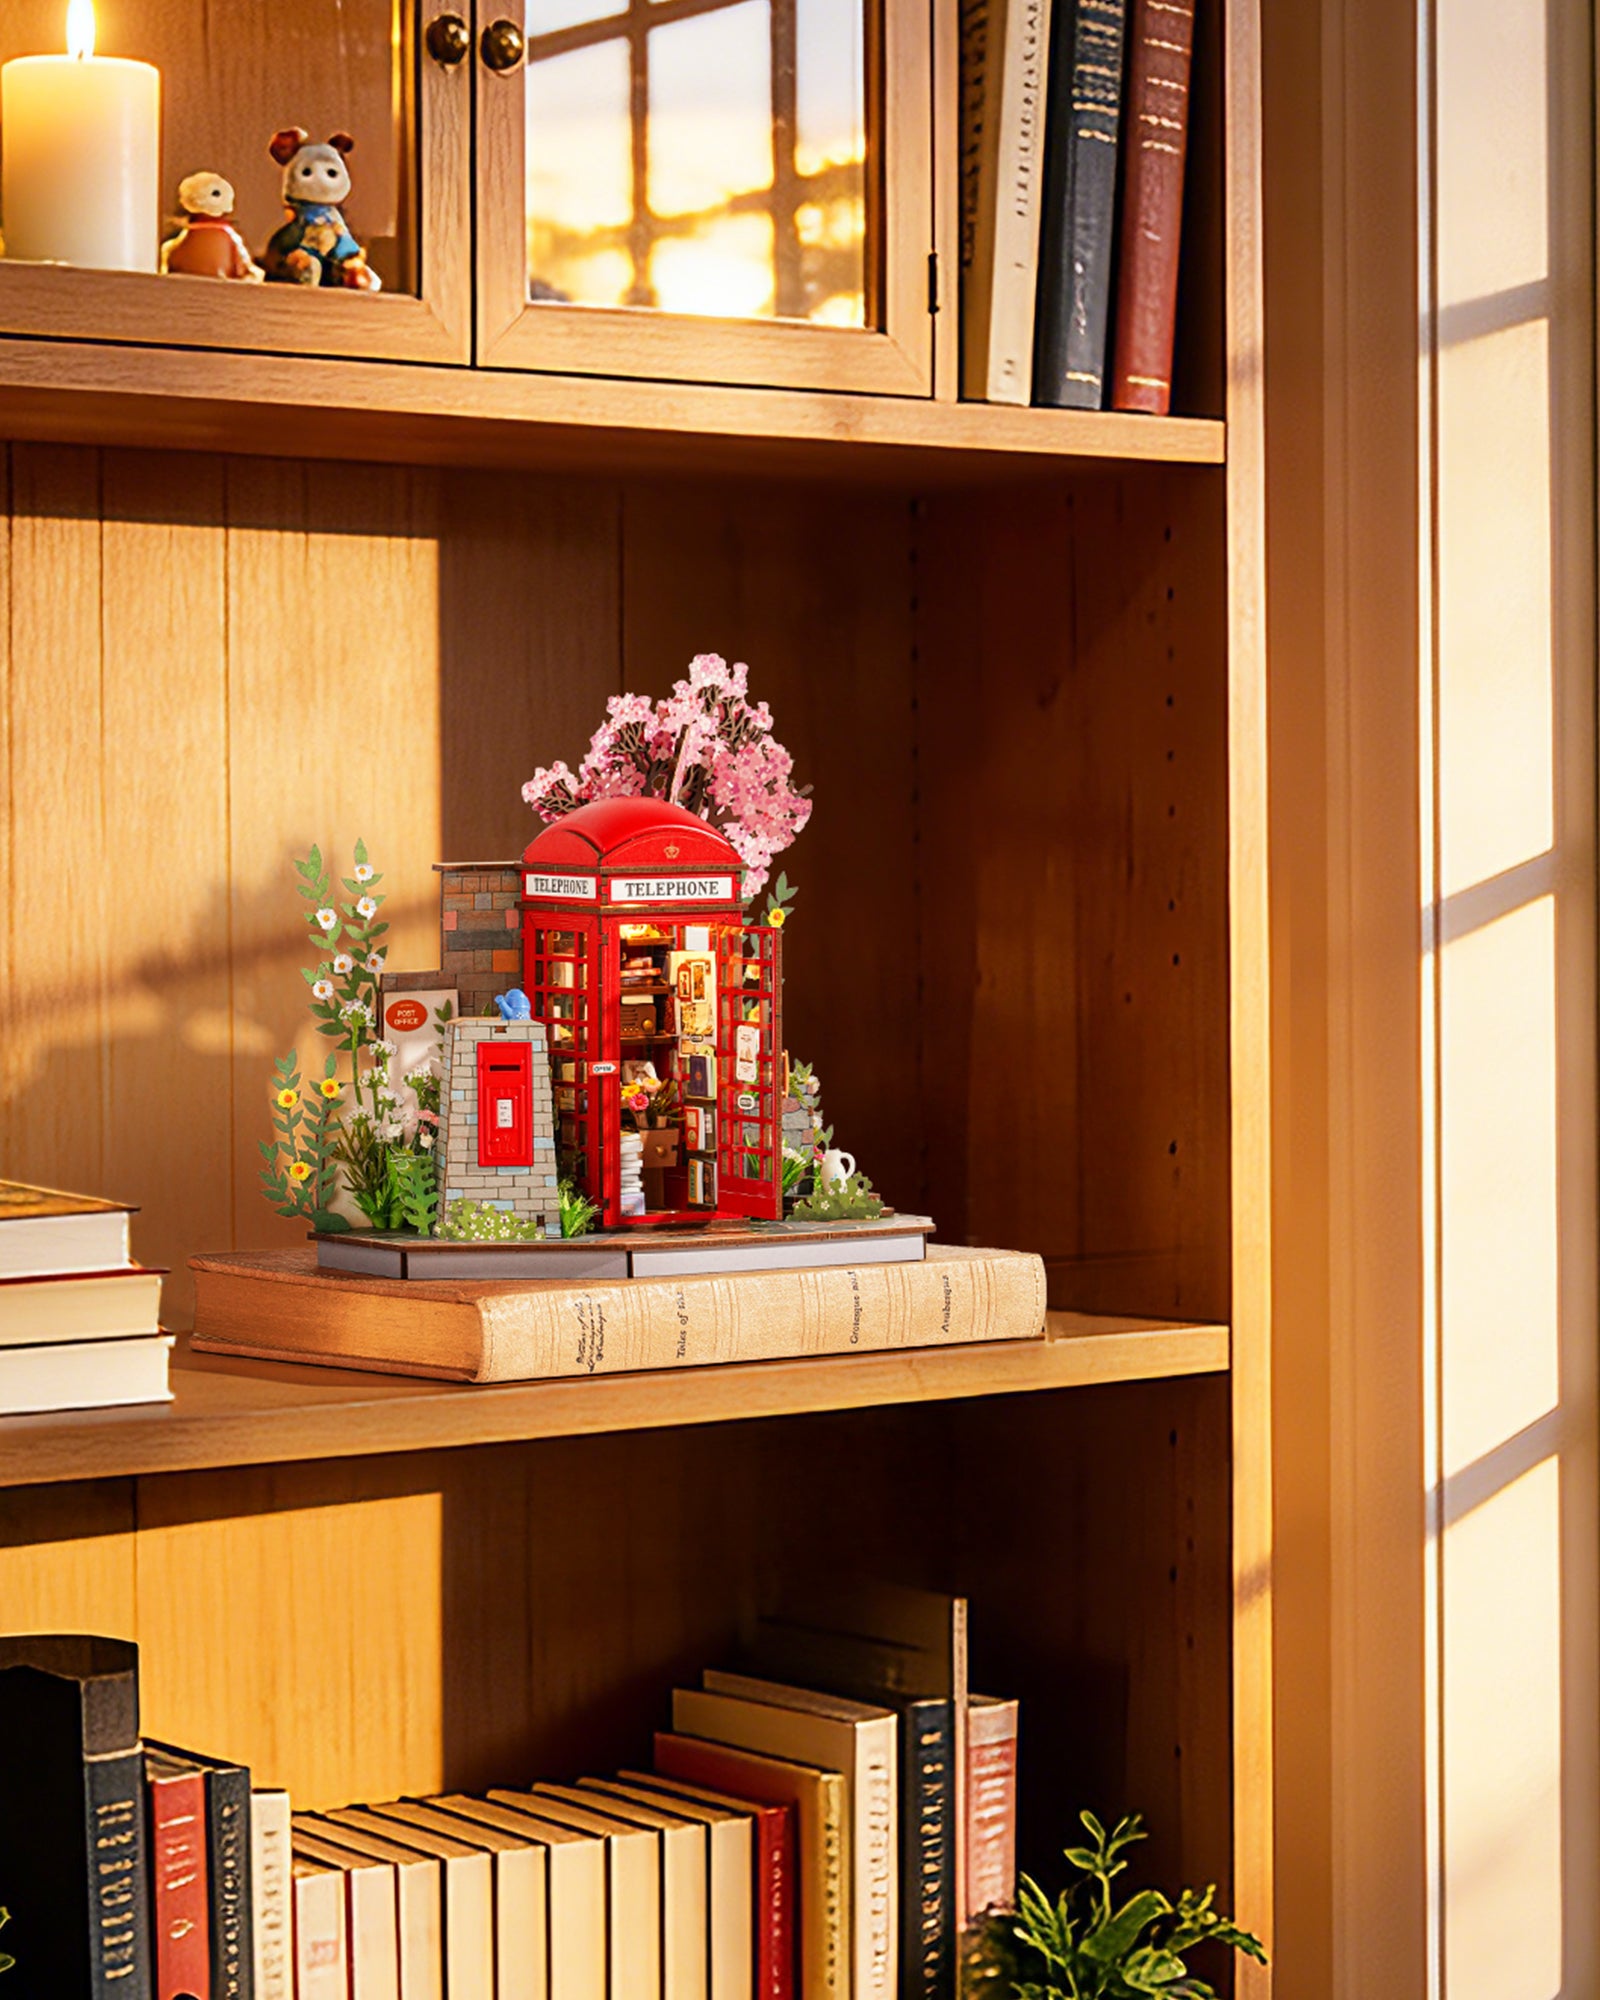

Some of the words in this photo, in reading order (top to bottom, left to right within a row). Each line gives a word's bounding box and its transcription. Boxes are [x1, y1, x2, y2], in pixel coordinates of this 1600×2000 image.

[533, 877, 589, 895] TELEPHONE
[625, 880, 720, 898] TELEPHONE
[397, 1009, 416, 1017] POST
[676, 1311, 689, 1326] of
[676, 1330, 687, 1359] Tales
